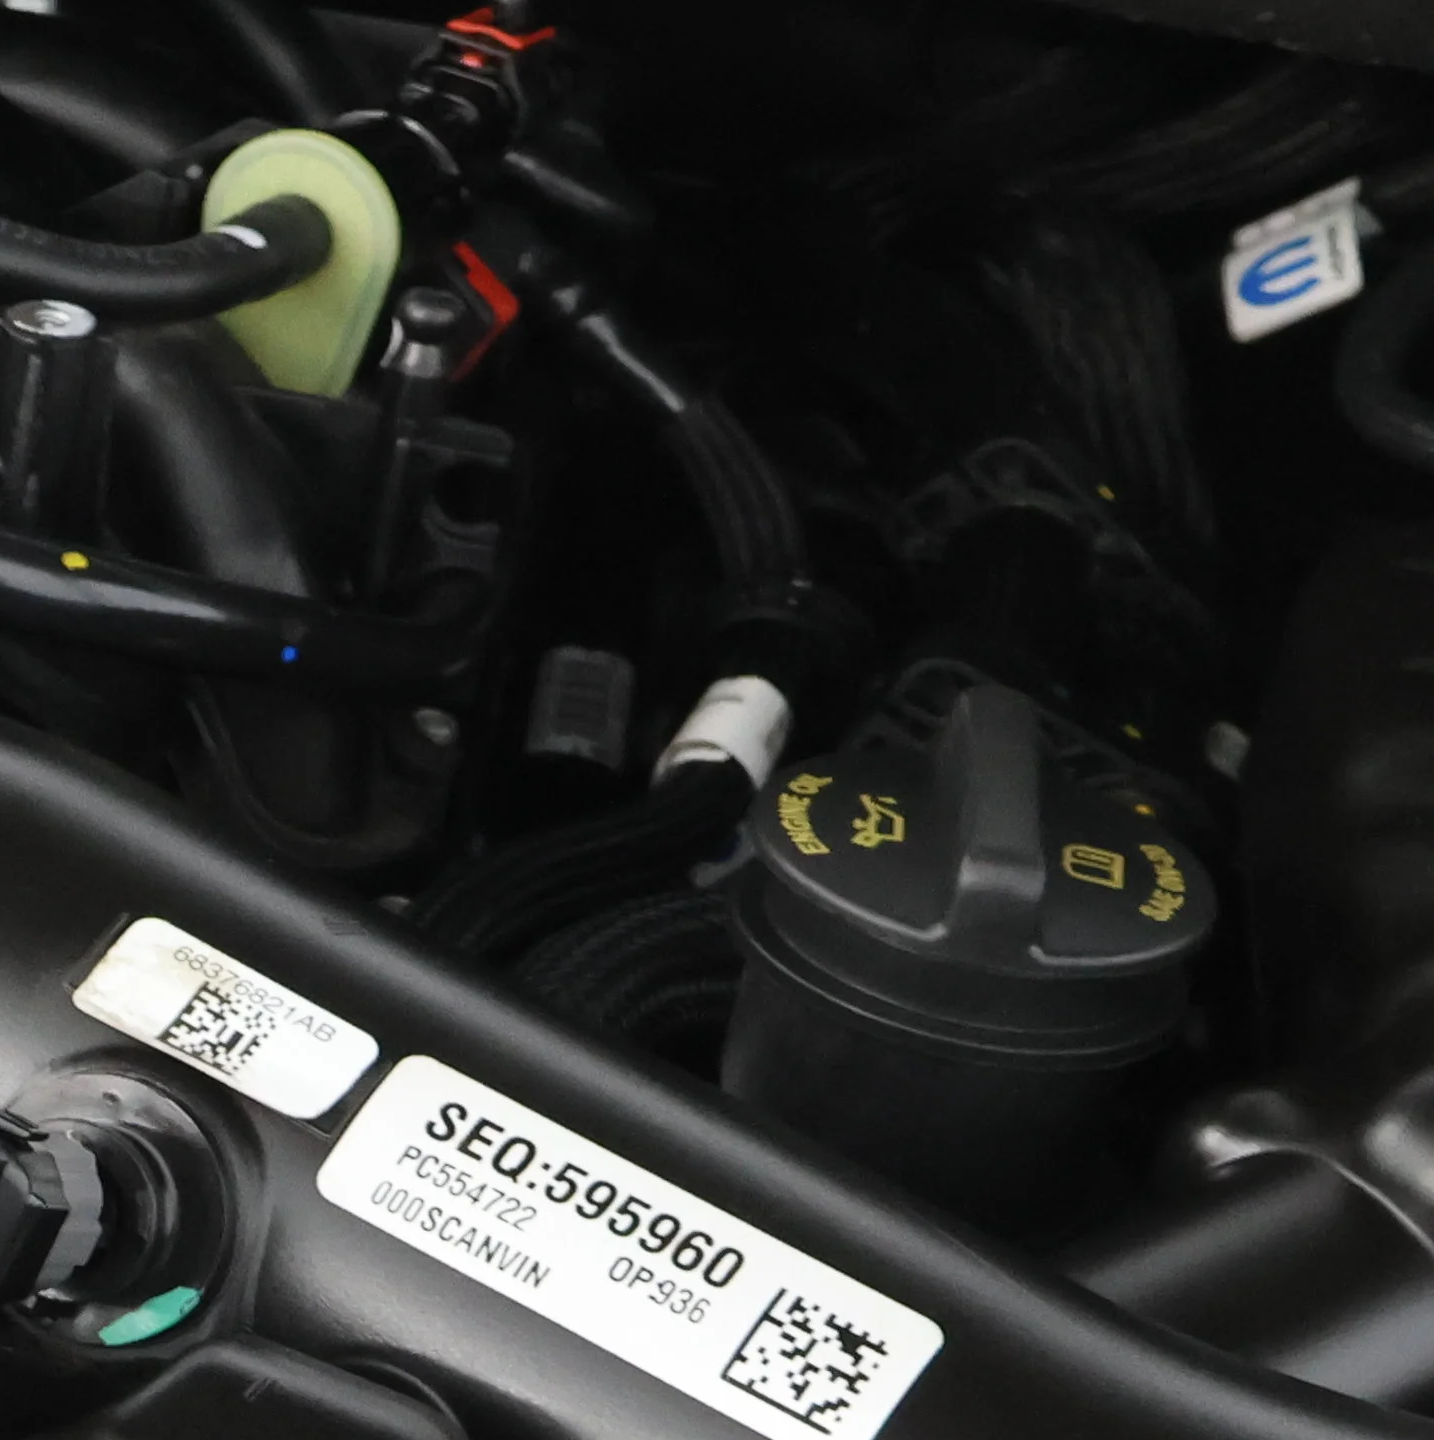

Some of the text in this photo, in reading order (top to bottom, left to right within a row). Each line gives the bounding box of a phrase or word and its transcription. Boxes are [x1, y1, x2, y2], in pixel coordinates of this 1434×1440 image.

[778, 793, 831, 855] ENGINE
[171, 943, 337, 1045] 68376821AB
[370, 1180, 552, 1289] 000SCANVIN
[396, 1143, 539, 1231] PC554722
[424, 1100, 745, 1289] SEQ:595960
